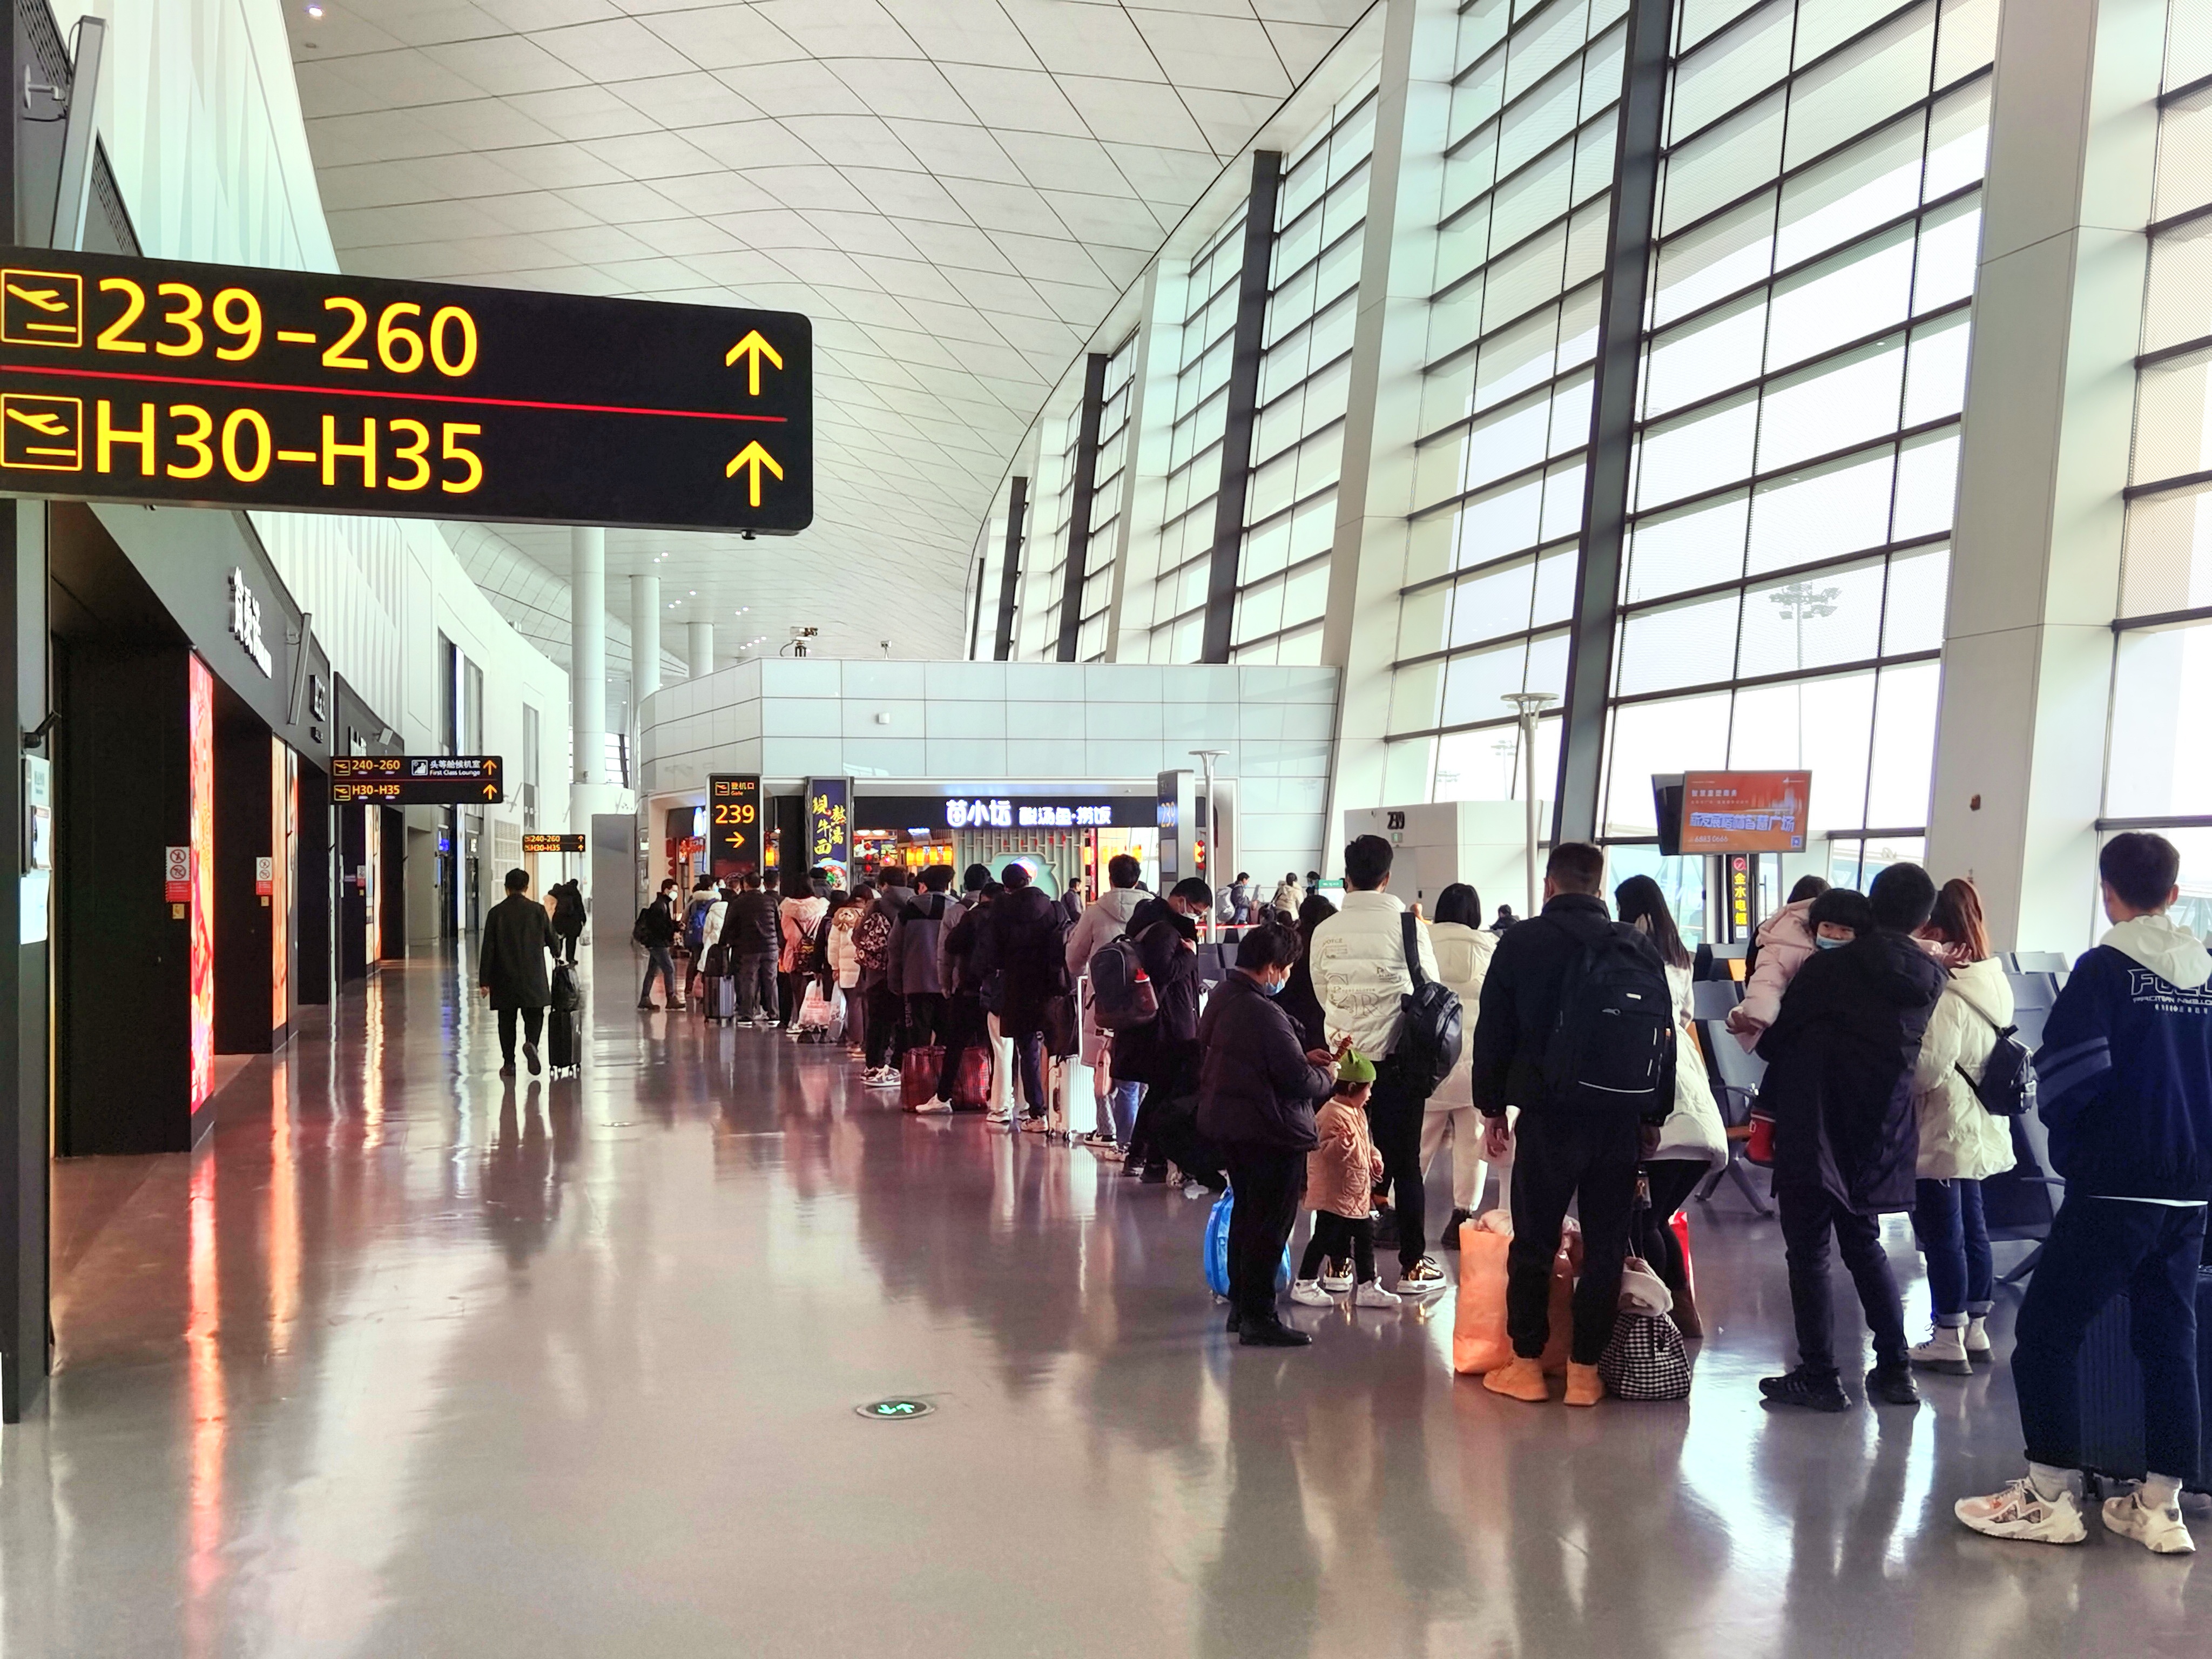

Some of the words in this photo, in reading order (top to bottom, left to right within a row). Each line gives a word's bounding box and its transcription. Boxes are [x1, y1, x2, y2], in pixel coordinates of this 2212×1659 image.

[97, 274, 477, 377] 239-260
[97, 400, 482, 494] H30-H35
[352, 760, 400, 770] 240-260
[430, 759, 481, 769] 头等舱候机室
[352, 785, 400, 795] H30-H35
[731, 782, 754, 790] 登机口
[715, 804, 755, 824] 239
[1161, 801, 1176, 827] 239
